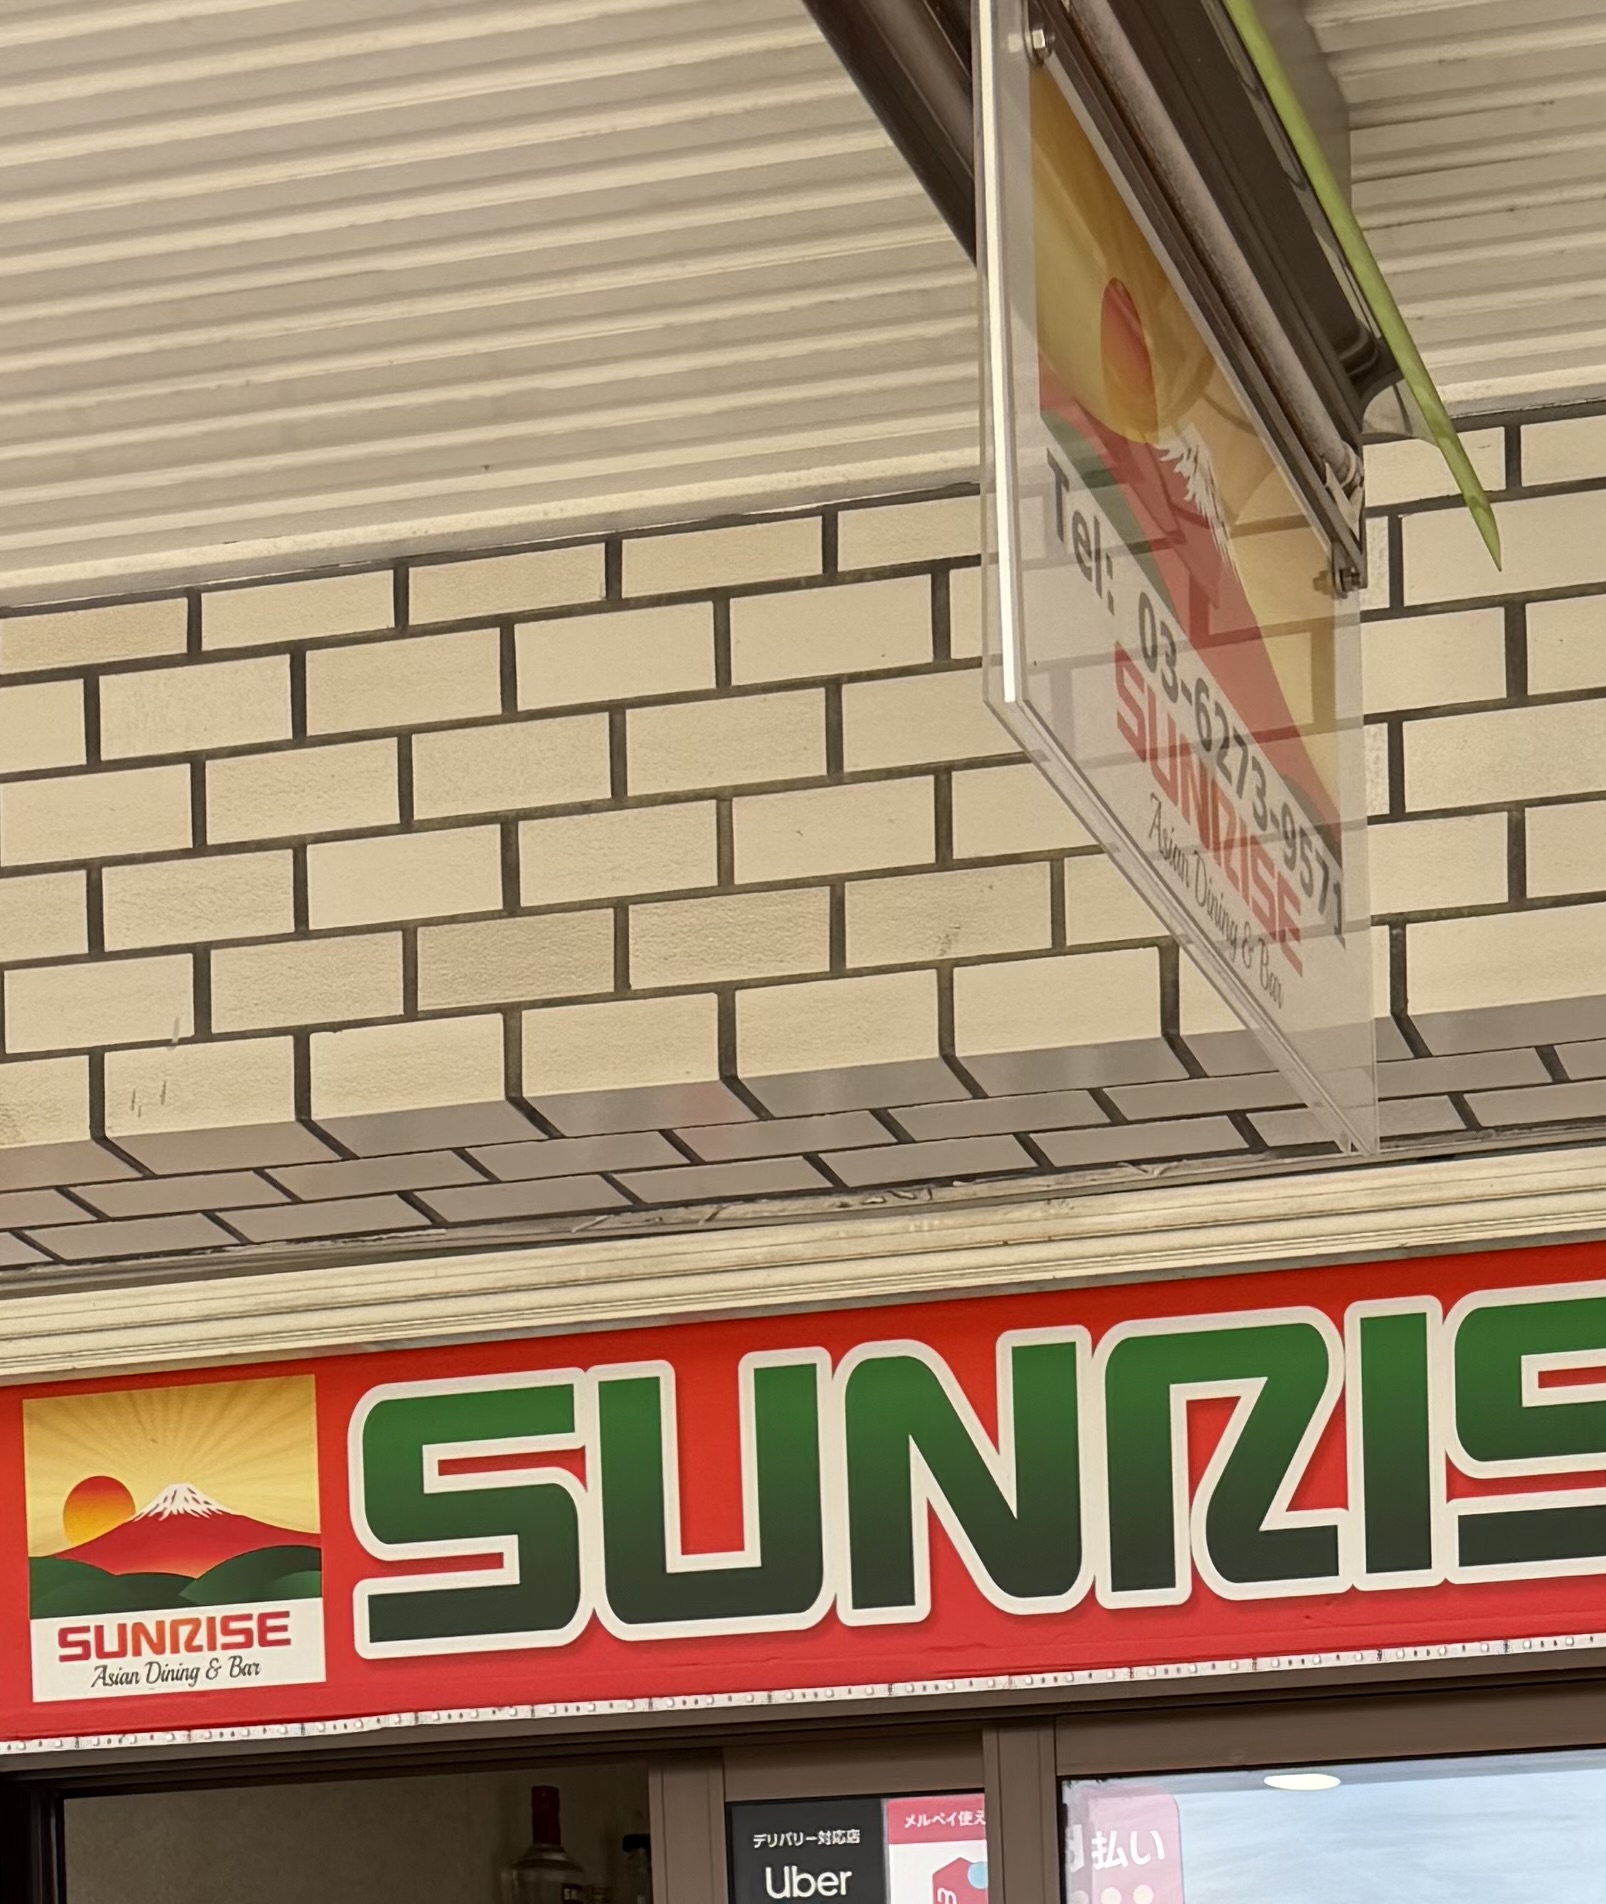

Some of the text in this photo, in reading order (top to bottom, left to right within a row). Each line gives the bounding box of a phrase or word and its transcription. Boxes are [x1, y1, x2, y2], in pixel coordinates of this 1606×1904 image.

[1045, 447, 1347, 948] Tel: 03-6273-9571
[1113, 641, 1304, 976] SUNRISE
[1147, 790, 1193, 892] Asian
[1190, 846, 1240, 958] Dining
[1256, 936, 1286, 1012] Bar
[58, 1610, 292, 1663] SUNRISE
[91, 1654, 262, 1688] Asian Dining & Bar
[752, 1829, 862, 1849] デリバリー対応店
[765, 1865, 852, 1899] Uber
